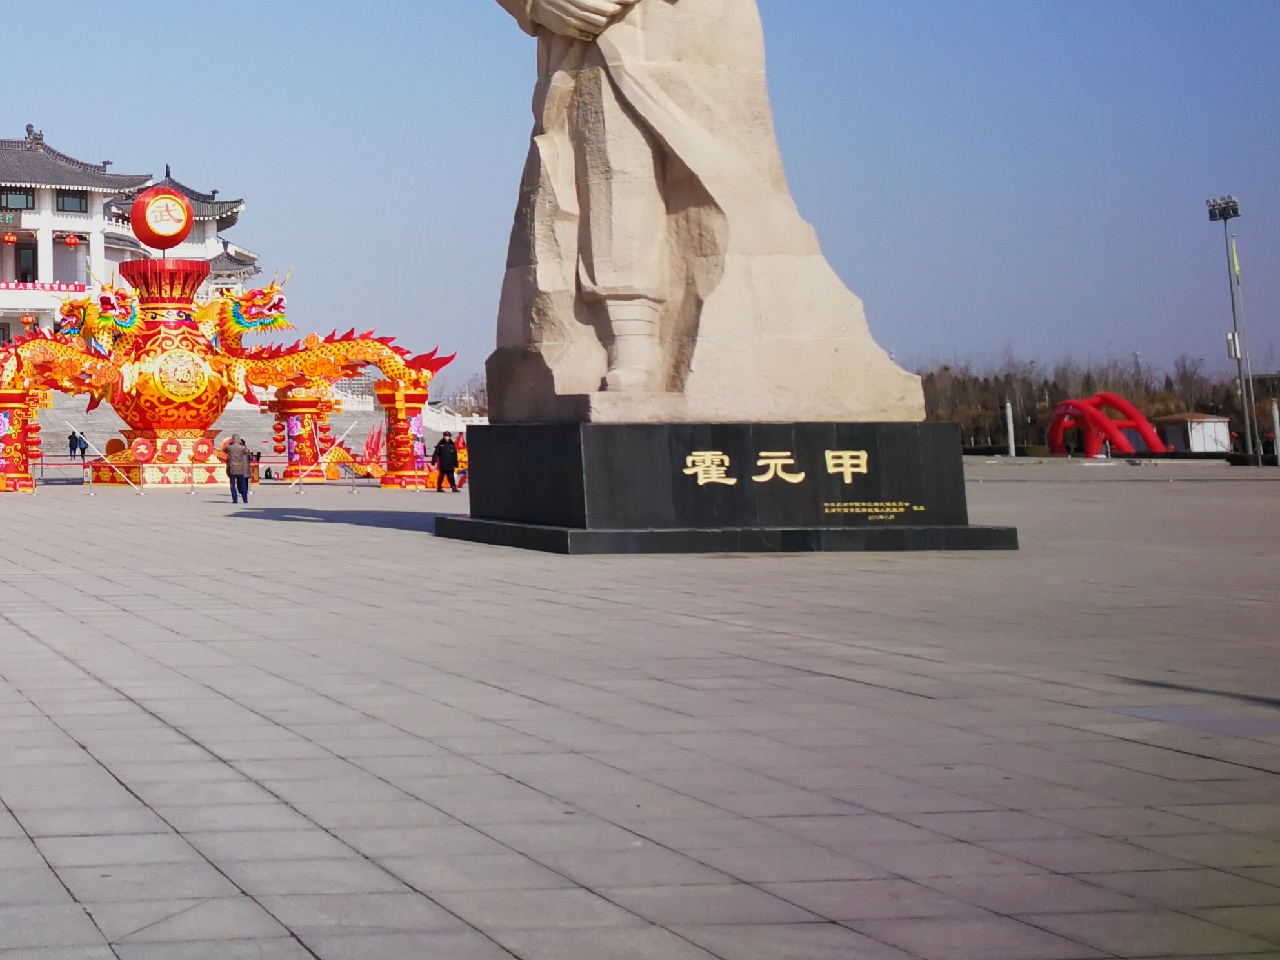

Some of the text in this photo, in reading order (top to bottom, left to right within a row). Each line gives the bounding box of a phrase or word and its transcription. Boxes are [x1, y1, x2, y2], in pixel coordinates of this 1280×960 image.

[150, 203, 183, 223] 武
[682, 449, 869, 486] 霍元甲
